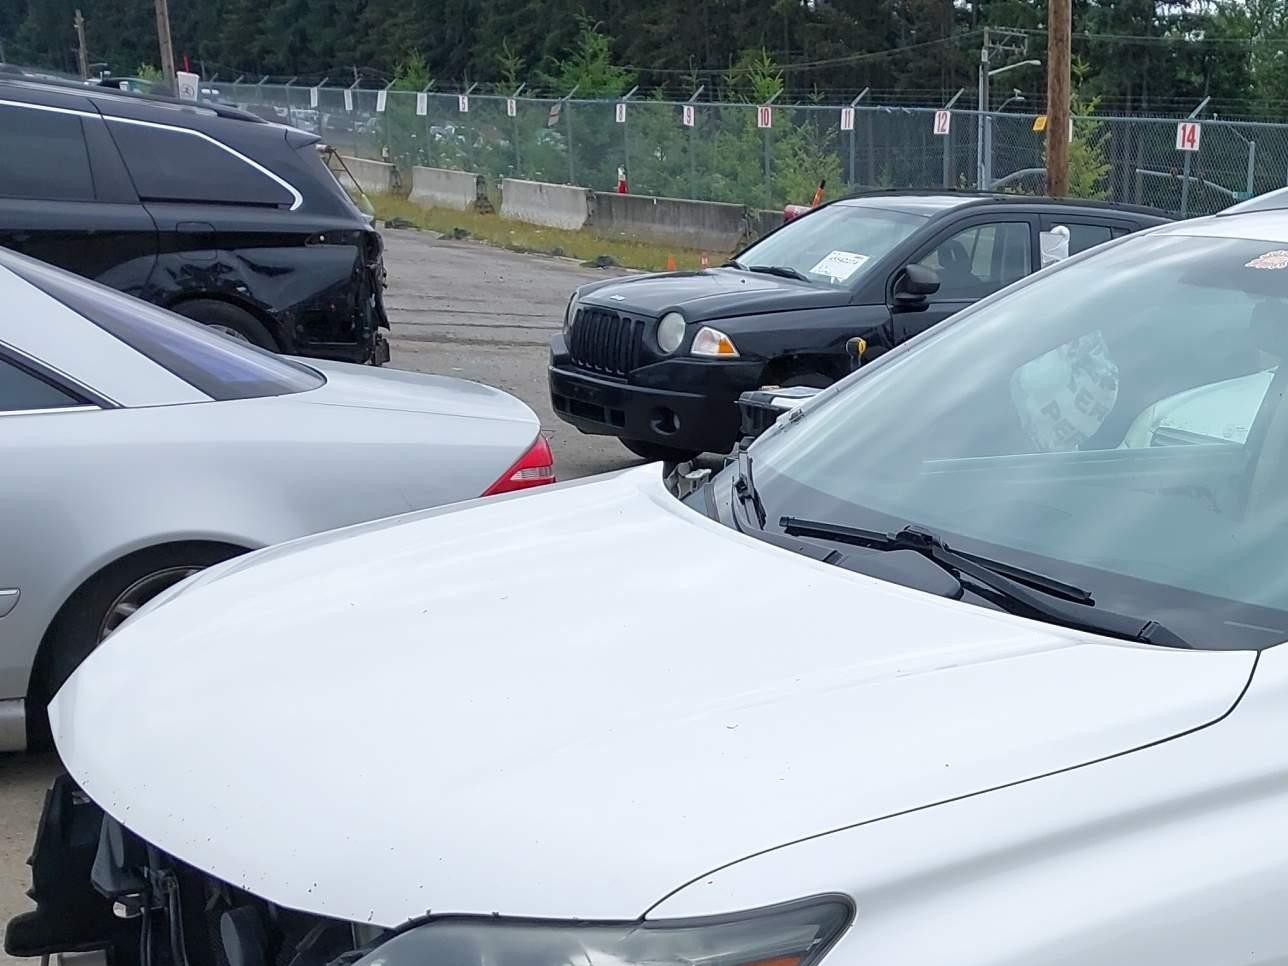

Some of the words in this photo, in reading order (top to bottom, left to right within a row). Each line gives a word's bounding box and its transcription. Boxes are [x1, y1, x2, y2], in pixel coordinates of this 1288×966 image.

[618, 104, 624, 121] 8
[686, 107, 692, 124] 9
[760, 108, 770, 127] 10
[844, 110, 852, 129] 11
[937, 112, 948, 132] 12
[1179, 124, 1197, 149] 14
